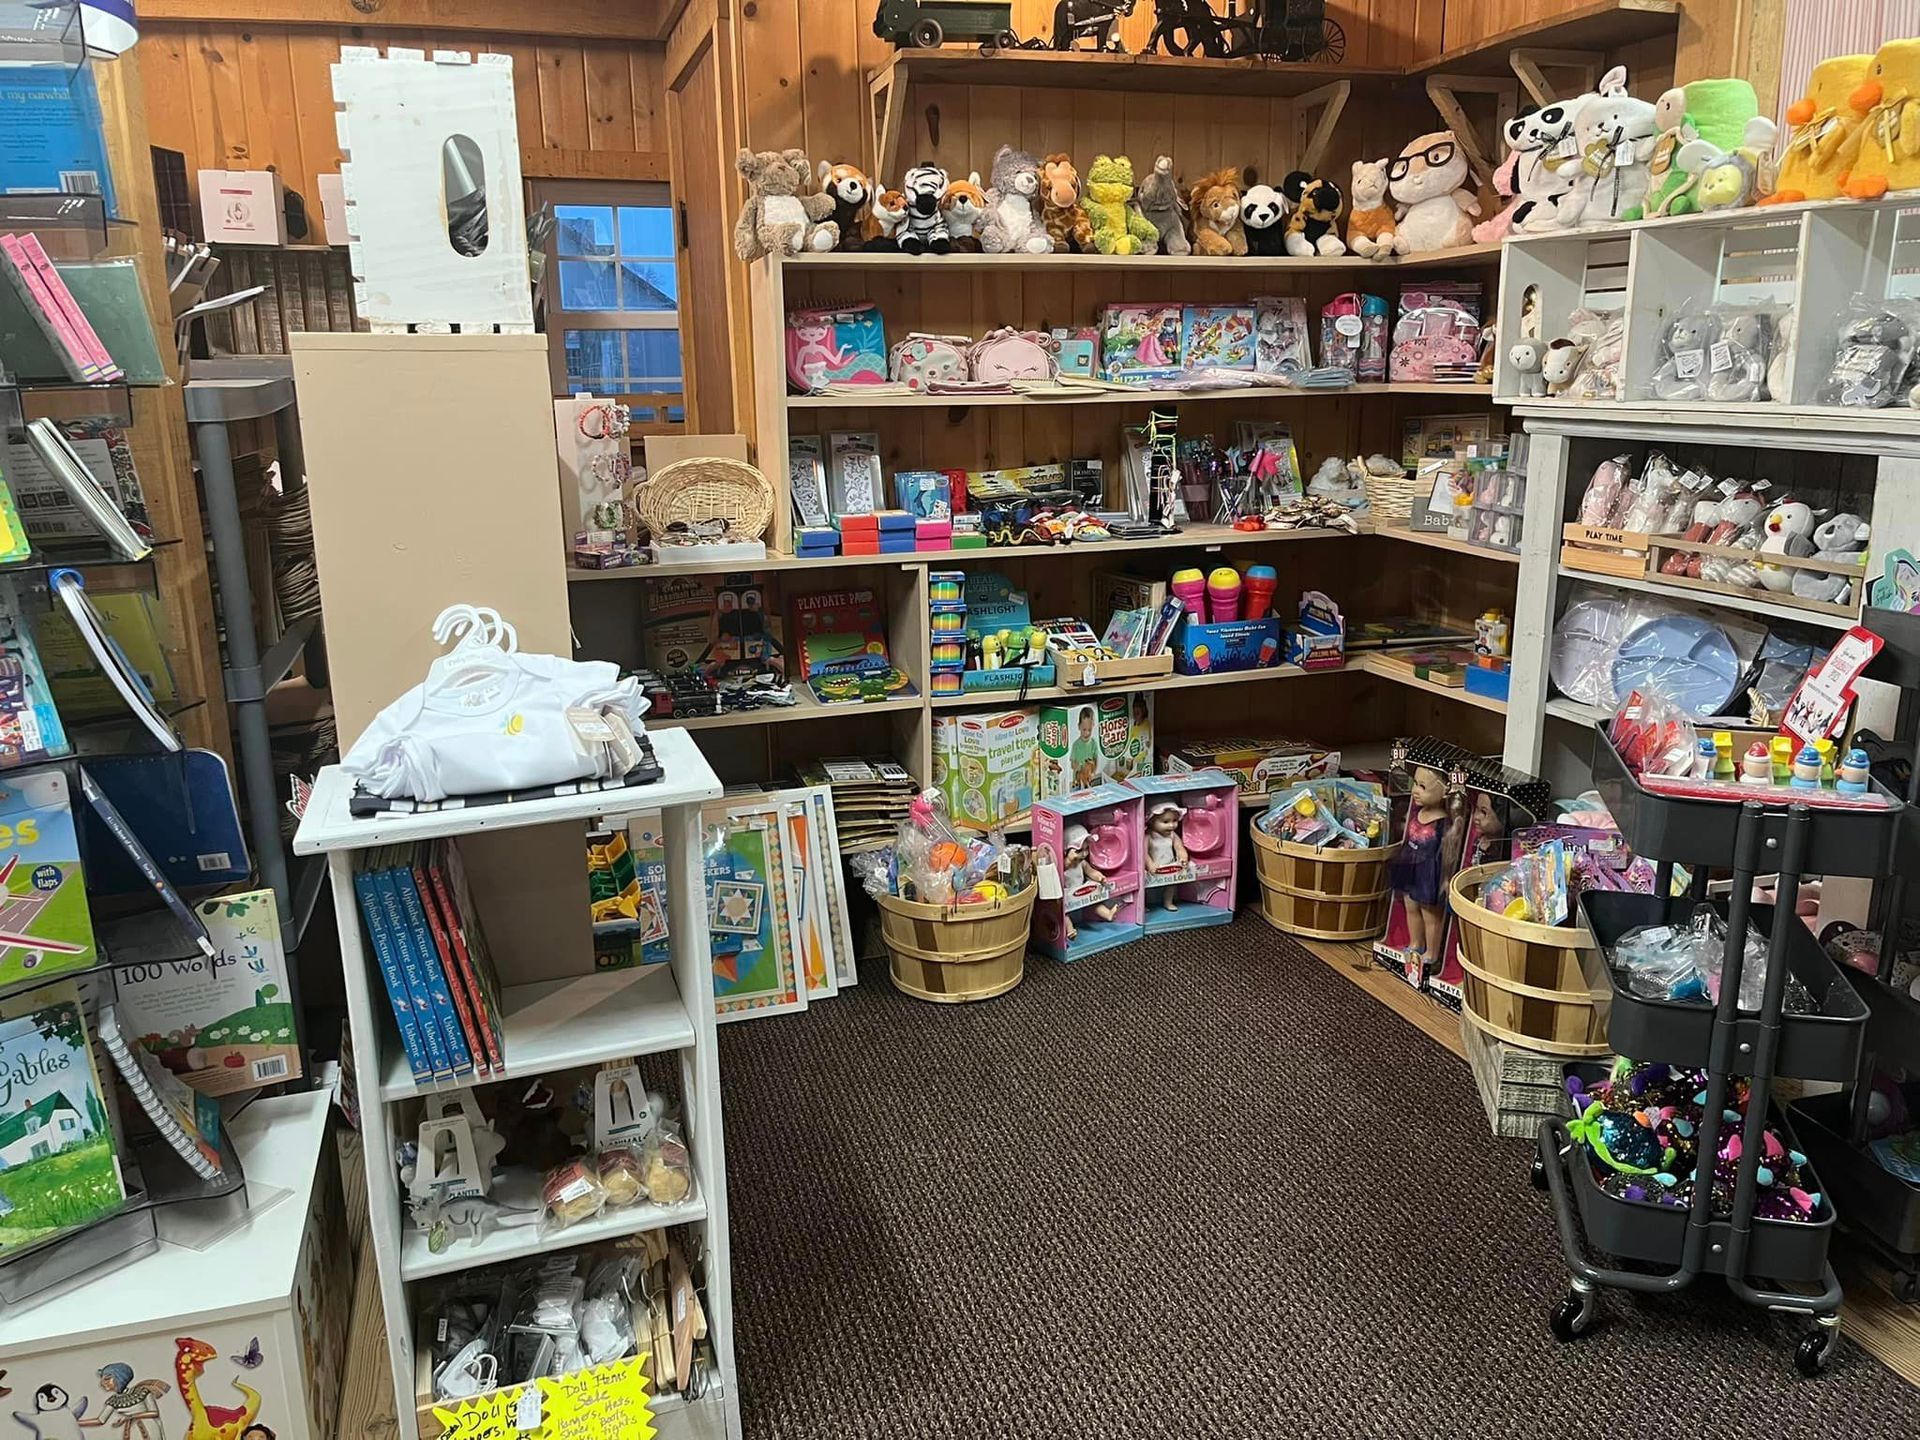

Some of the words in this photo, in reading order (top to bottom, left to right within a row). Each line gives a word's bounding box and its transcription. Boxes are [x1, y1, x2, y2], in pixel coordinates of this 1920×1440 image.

[1423, 514, 1451, 526] Bab
[1585, 530, 1604, 539] PLAY
[1605, 533, 1623, 543] TIME
[797, 593, 847, 610] PLAYDATE
[967, 604, 1017, 616] ASHLIGHT
[984, 672, 1033, 682] FLASHLIGT
[1100, 717, 1128, 736] Horse
[1101, 729, 1127, 748] Care
[988, 740, 1014, 759] travel
[1015, 737, 1036, 751] time
[1243, 780, 1260, 792] Set
[36, 867, 56, 879] with
[1174, 873, 1193, 882] Love
[37, 876, 59, 890] flaps
[121, 962, 162, 986] 100
[169, 949, 237, 975] Wods
[363, 892, 382, 932] Alphabet
[376, 933, 391, 964] Picture
[387, 965, 401, 988] Book
[404, 1022, 420, 1058] Usborne
[383, 891, 401, 931] Alphabet
[396, 931, 410, 963] Picture
[406, 964, 420, 987] Book
[424, 1021, 440, 1056] Usborne
[401, 886, 420, 926] Alphabet
[415, 928, 429, 958] Picture
[424, 959, 439, 982] Book
[443, 1015, 458, 1051] Usborne
[1439, 982, 1461, 996] MAYA
[561, 1379, 588, 1398] Doll
[463, 1405, 500, 1432] Doll
